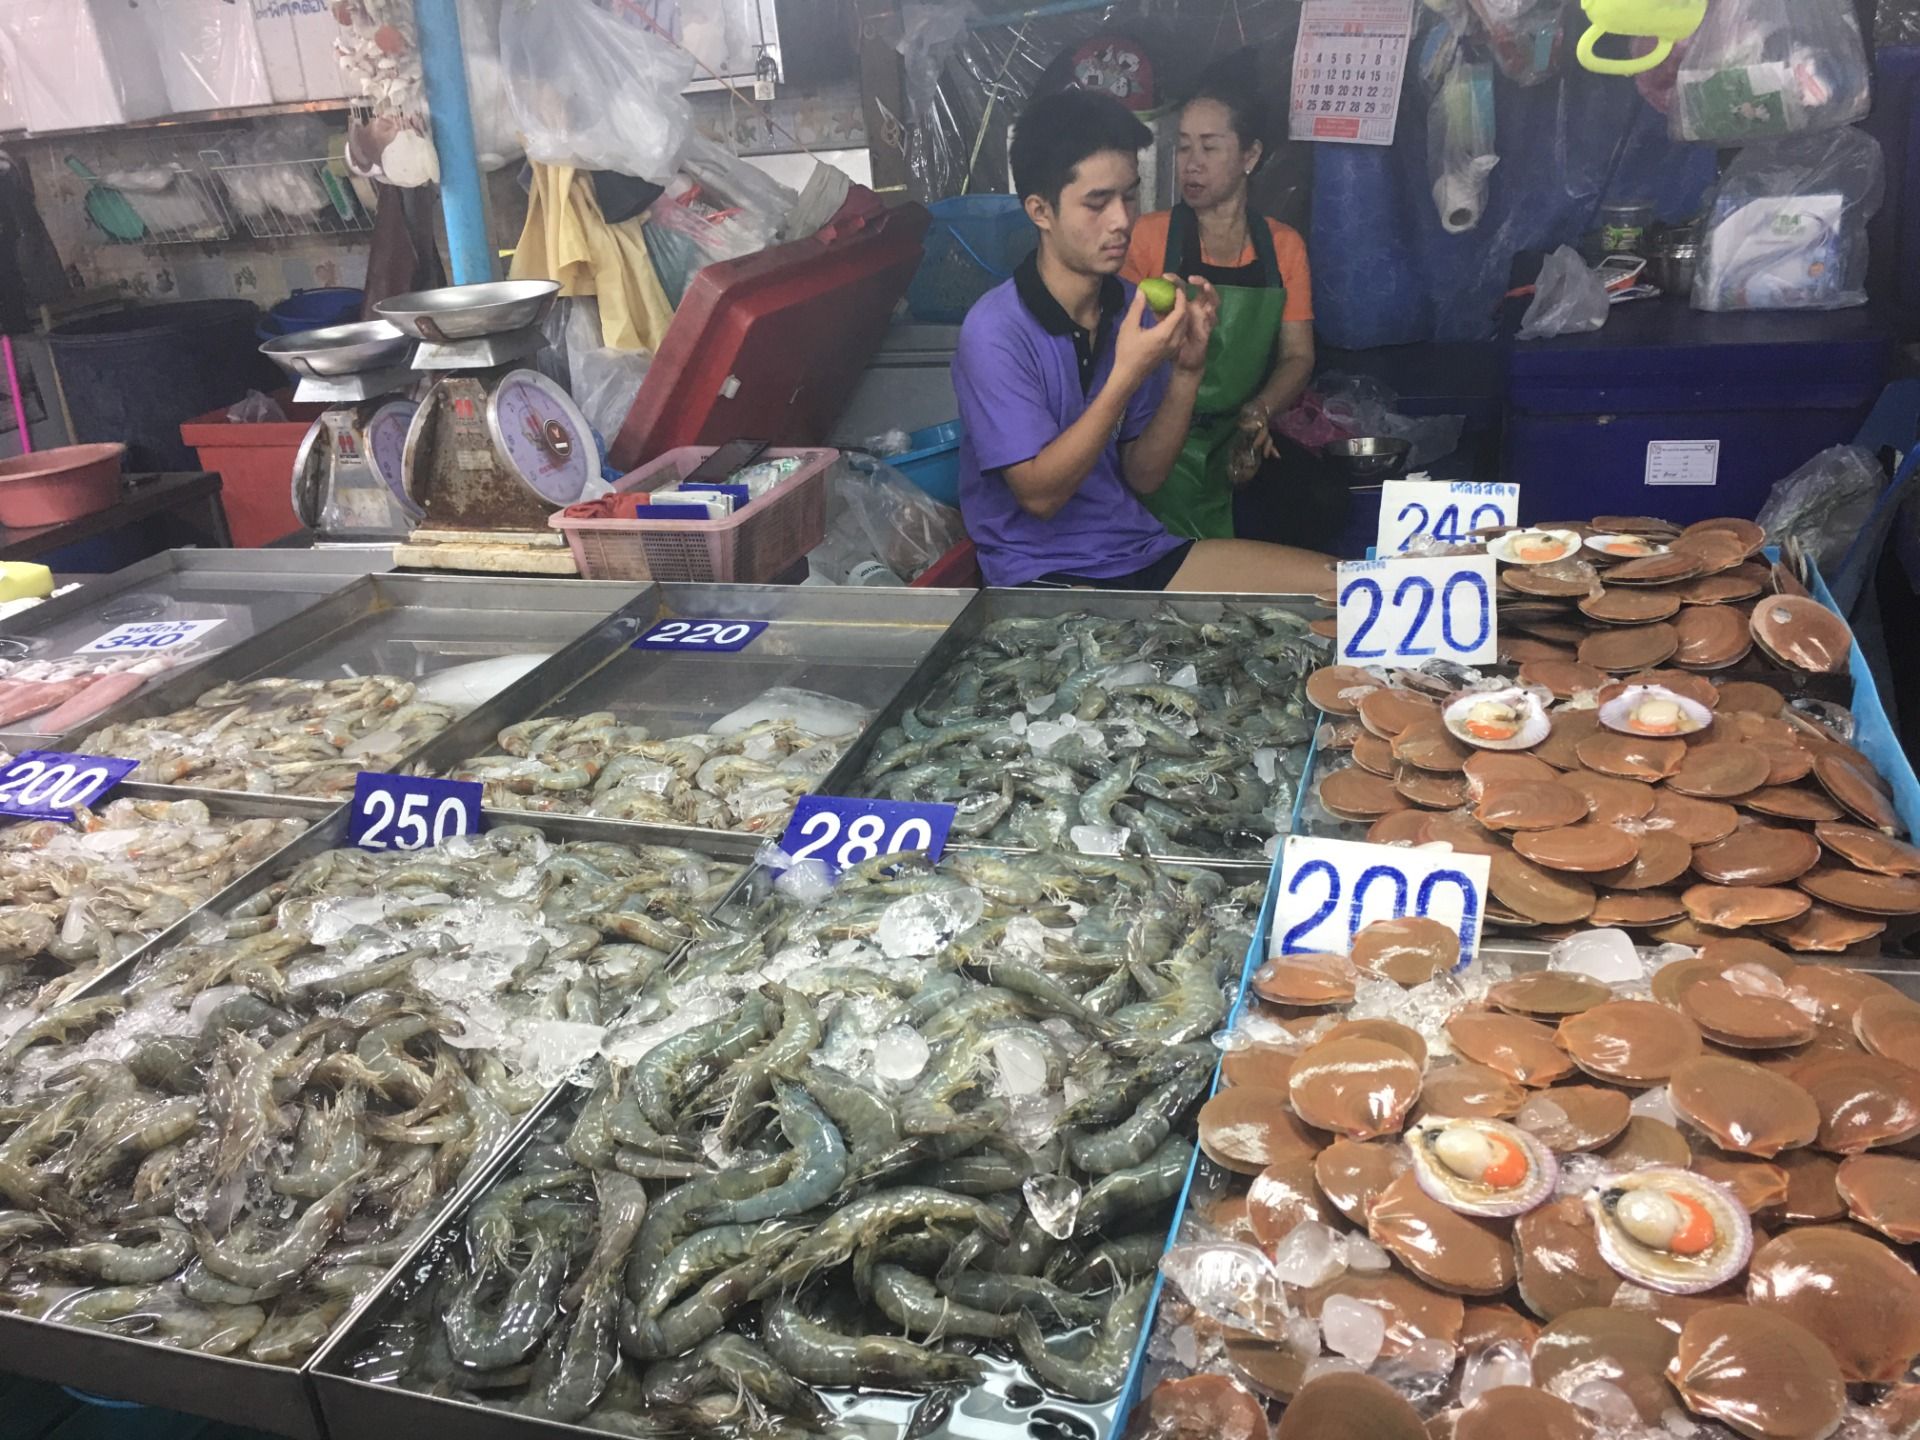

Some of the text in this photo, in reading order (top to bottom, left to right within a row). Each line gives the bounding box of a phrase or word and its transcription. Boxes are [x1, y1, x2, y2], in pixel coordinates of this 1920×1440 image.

[1297, 83, 1393, 98] 17 18 19 20 21 22 23
[1299, 68, 1309, 79] 10
[1327, 68, 1337, 80] 12
[1342, 69, 1352, 80] 13
[1356, 69, 1366, 81] 14
[1370, 70, 1381, 82] 15
[1385, 70, 1396, 82] 16
[1295, 99, 1391, 115] 24 25 26 27 28 29 30
[1397, 502, 1506, 552] 240
[646, 622, 750, 644] 220
[1339, 570, 1490, 658] 220
[95, 632, 185, 650] 340
[0, 760, 109, 809] 200
[358, 789, 467, 850] 250
[792, 811, 932, 870] 280
[1281, 859, 1478, 974] 200
